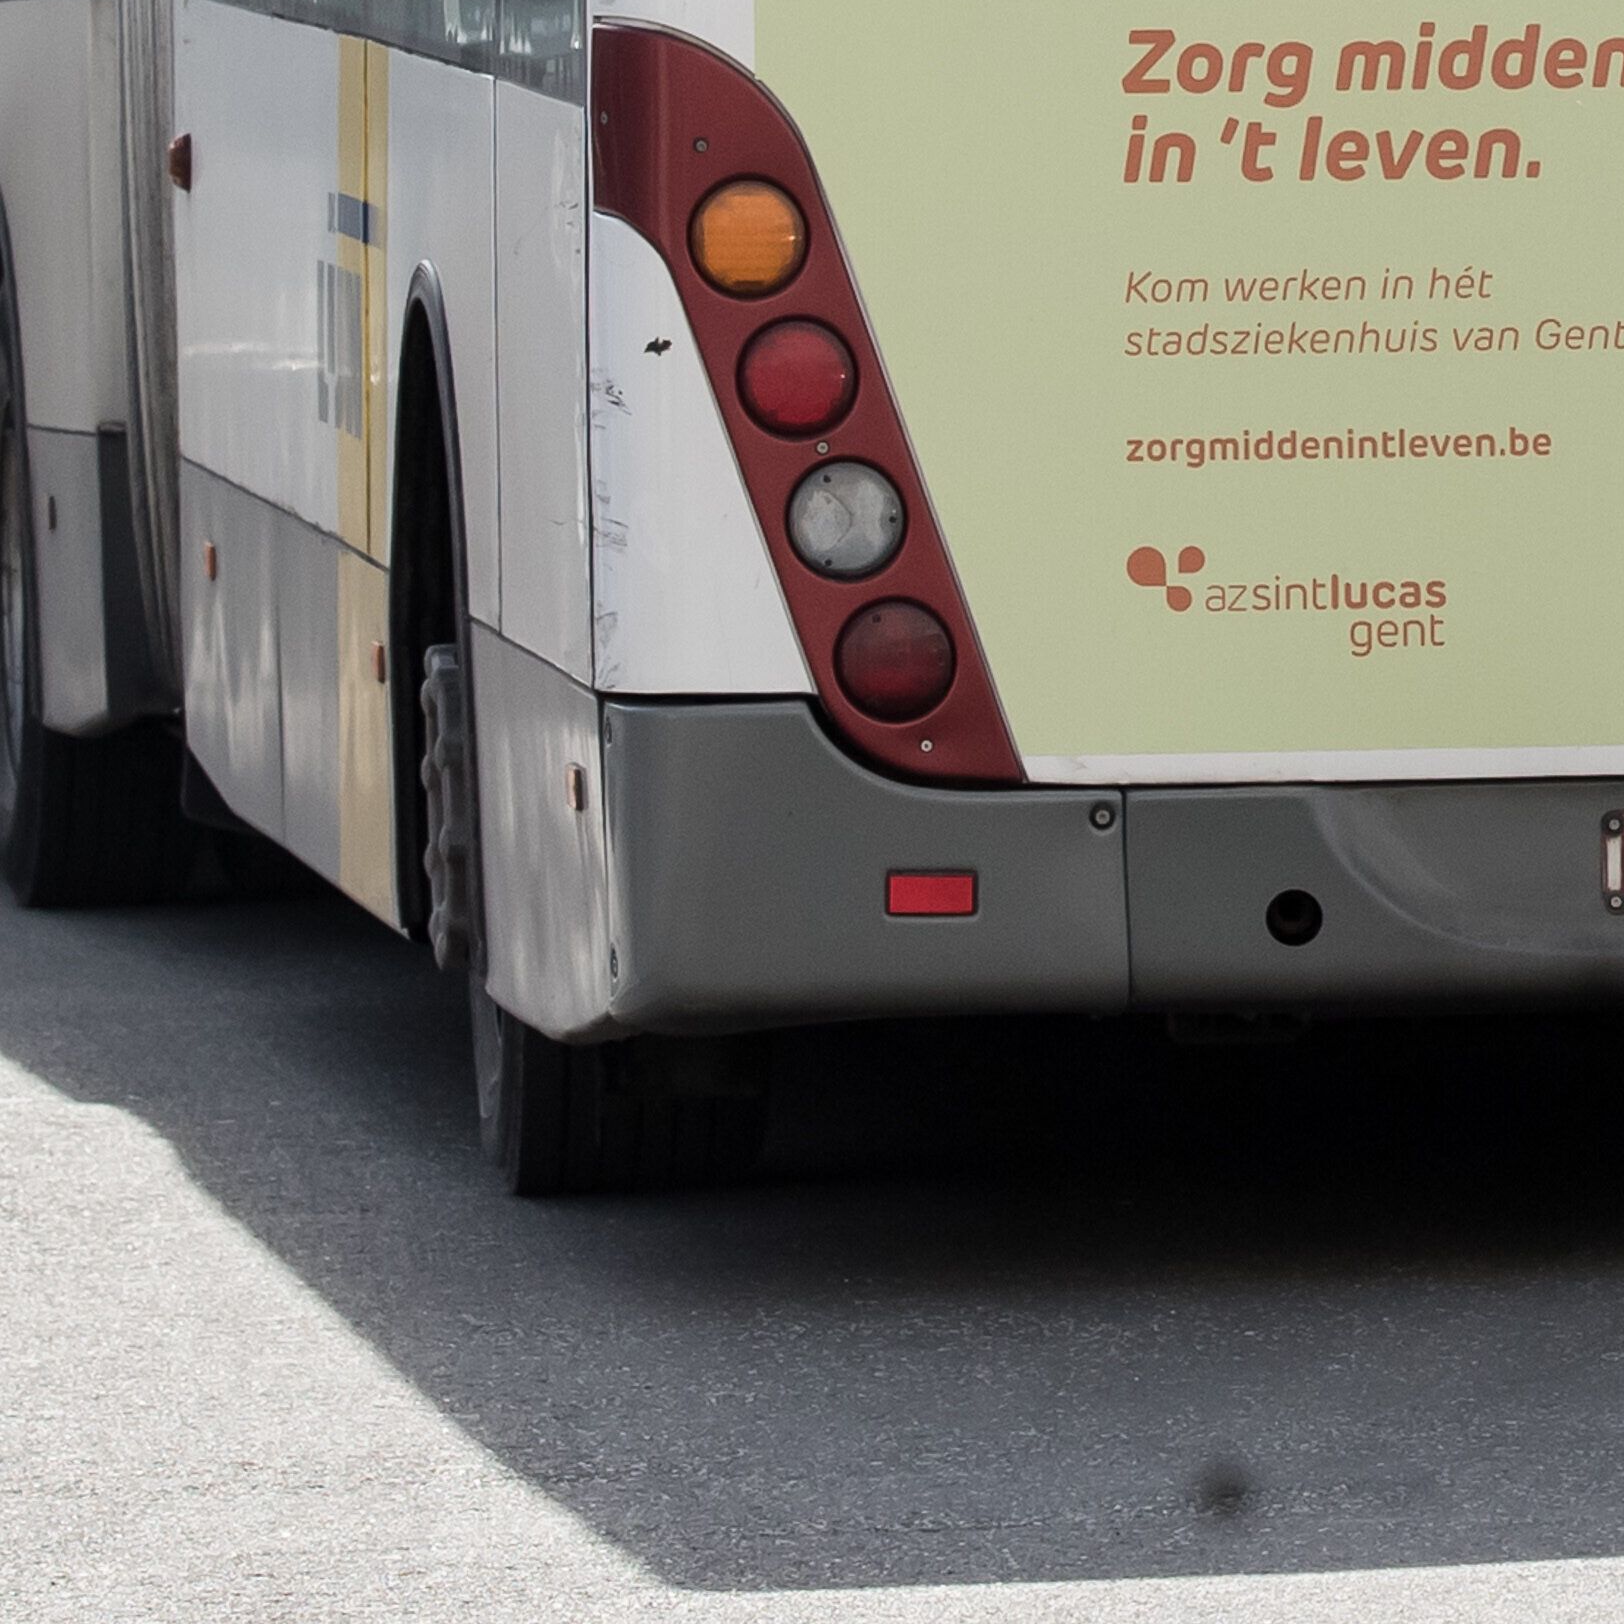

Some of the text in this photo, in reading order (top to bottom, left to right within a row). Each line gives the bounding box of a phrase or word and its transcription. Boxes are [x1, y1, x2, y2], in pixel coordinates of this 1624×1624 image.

[1121, 29, 1314, 108] Zorg
[1123, 115, 1197, 183] in
[1297, 116, 1542, 182] leven.
[1124, 265, 1494, 304] Kom werken in hét
[1123, 320, 1439, 357] stadsziekenhuis
[1453, 323, 1520, 352] van
[1125, 426, 1553, 469] zorgmiddenintleven.be
[1349, 612, 1446, 657] gent
